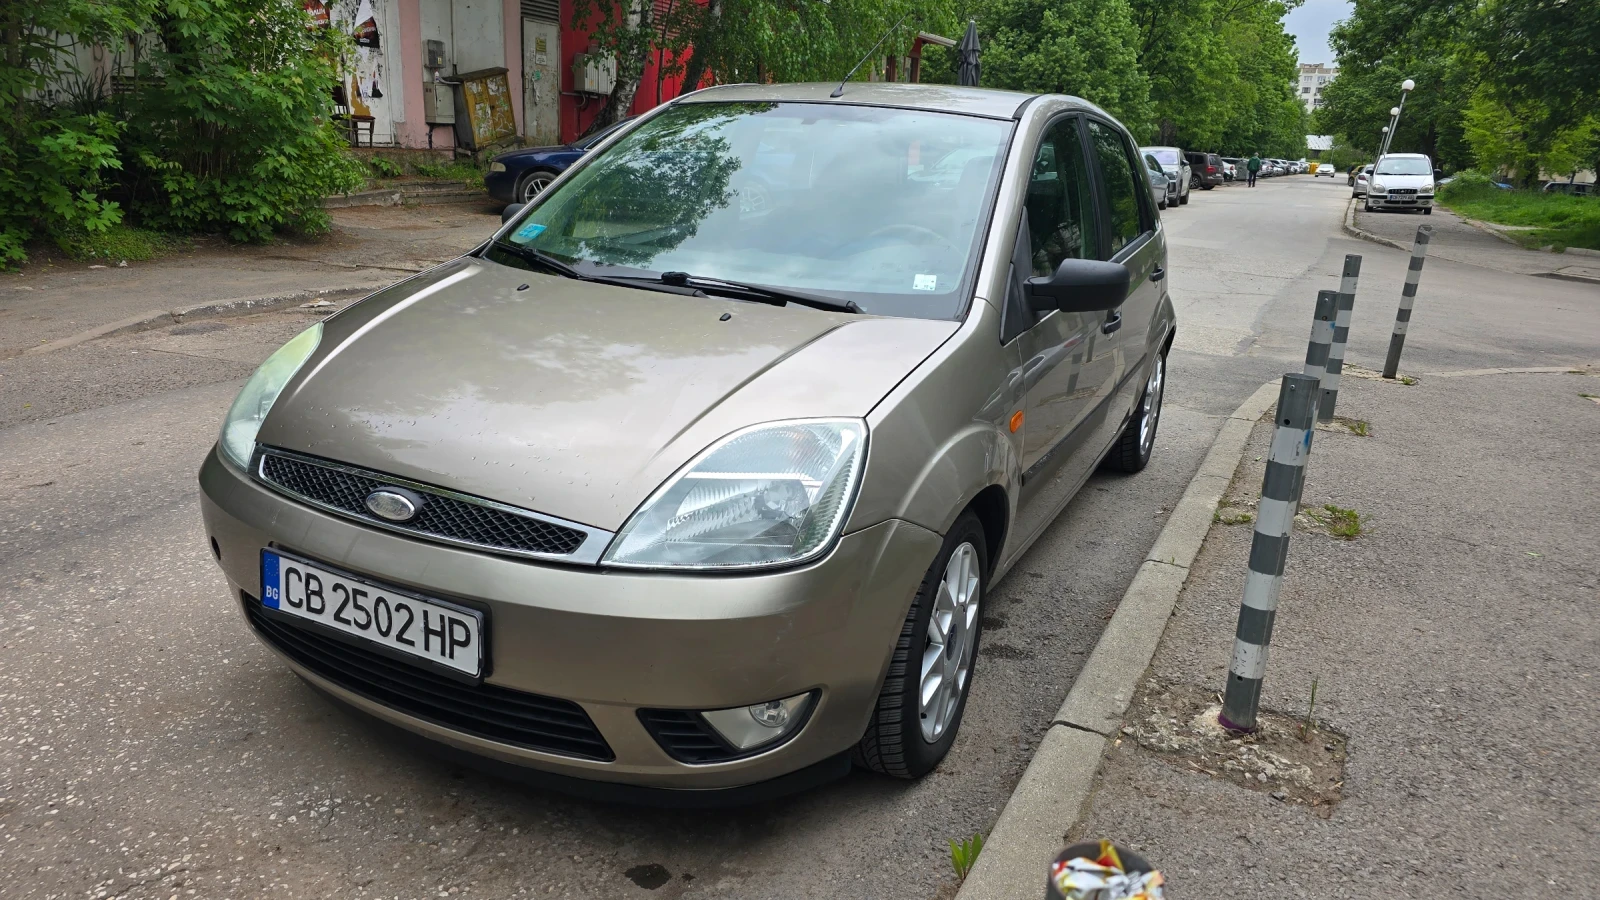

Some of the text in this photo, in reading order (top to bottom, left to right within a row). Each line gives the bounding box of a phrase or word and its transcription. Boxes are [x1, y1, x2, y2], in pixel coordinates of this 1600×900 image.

[266, 585, 278, 600] BG
[285, 567, 471, 660] CB 2502 HP
